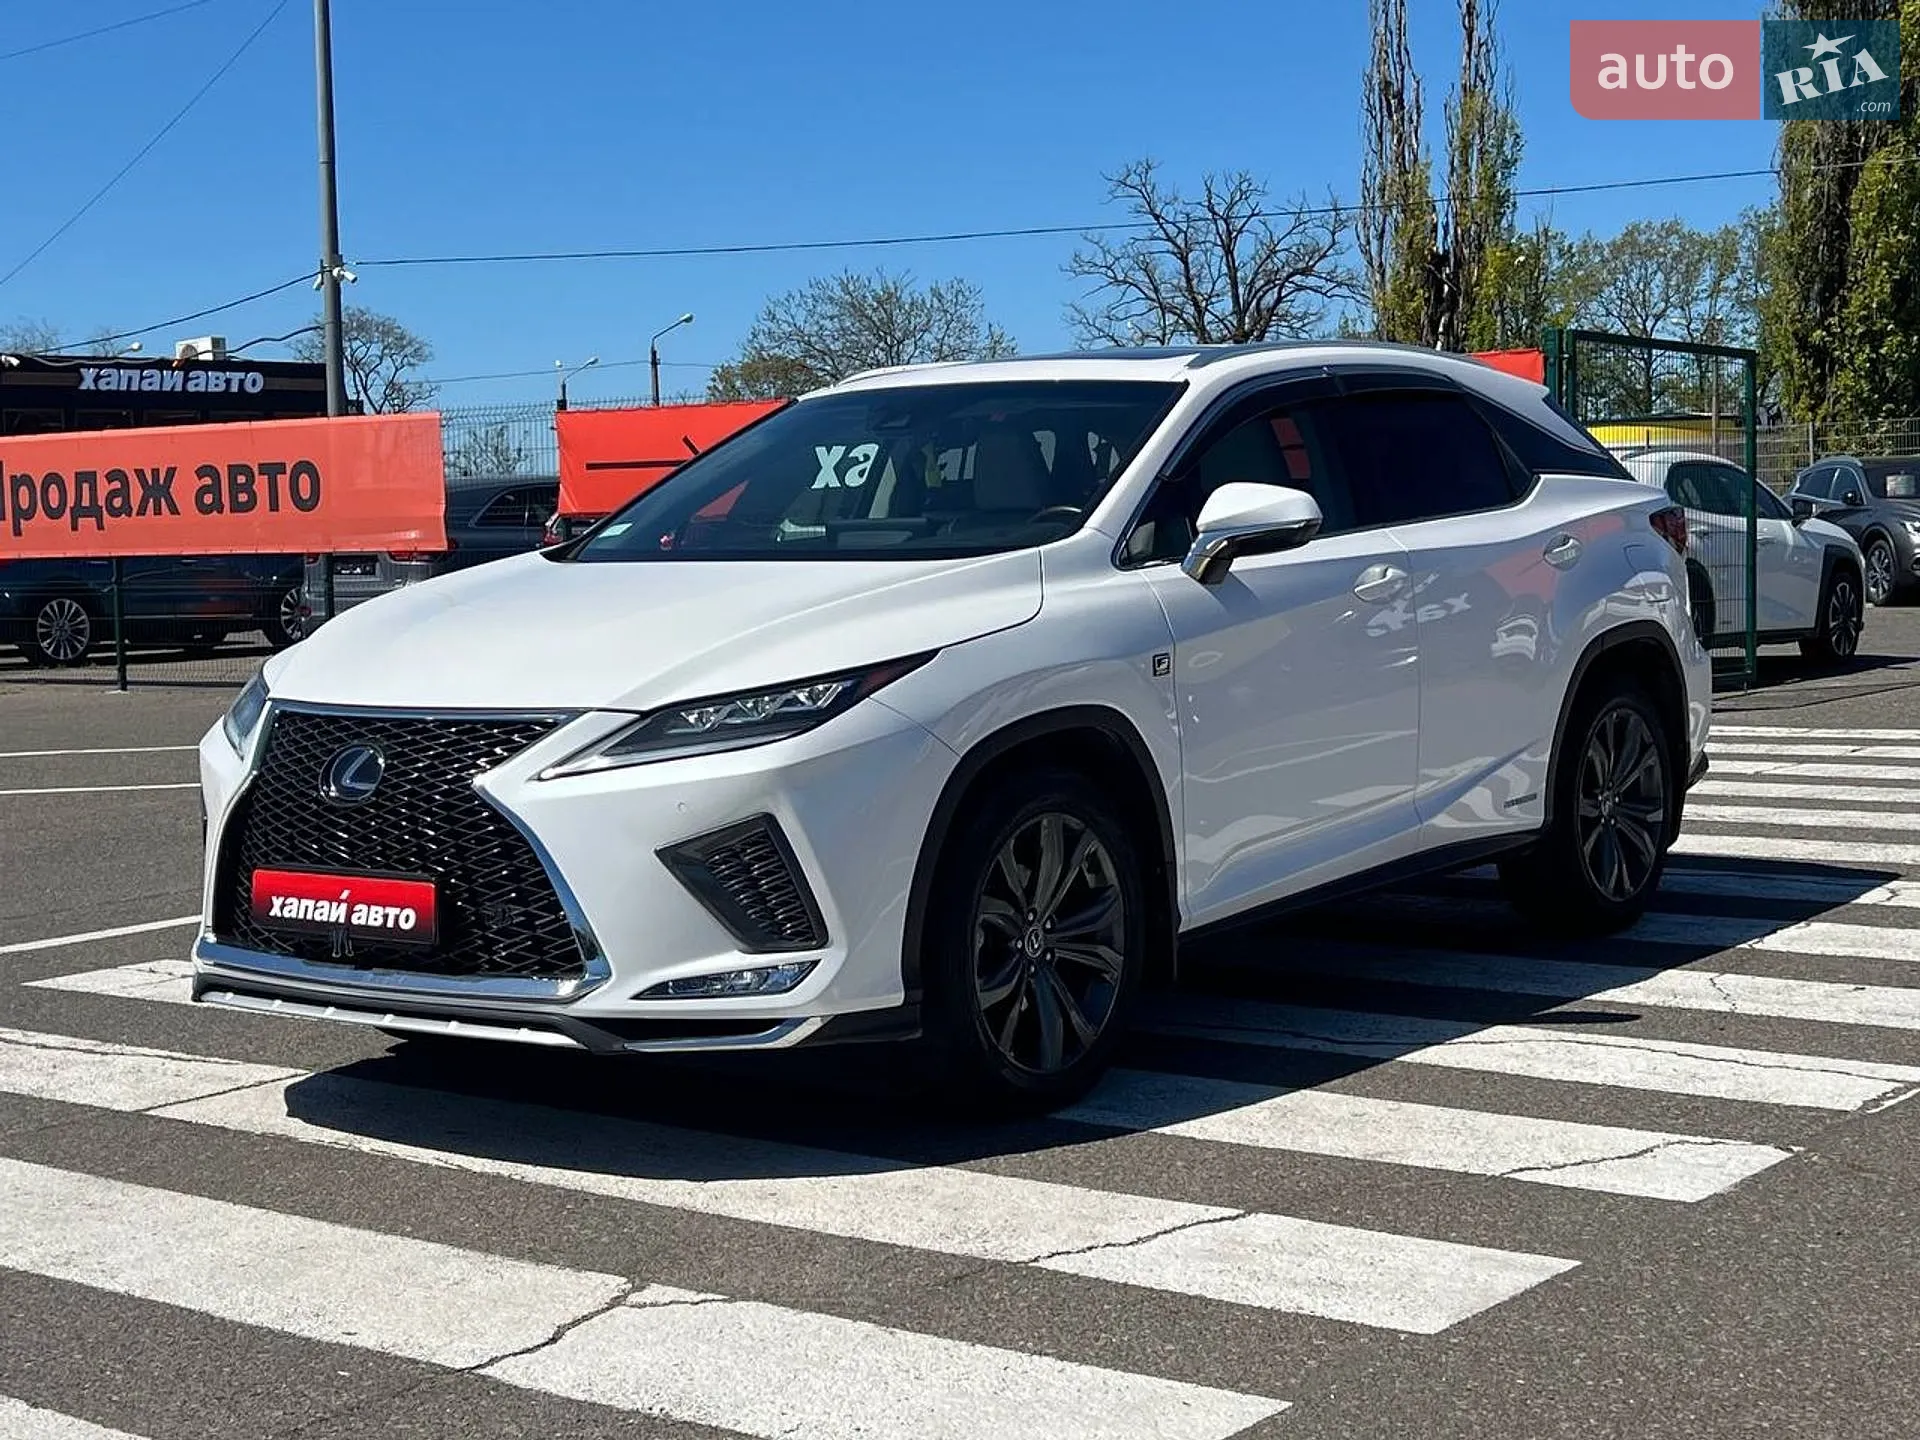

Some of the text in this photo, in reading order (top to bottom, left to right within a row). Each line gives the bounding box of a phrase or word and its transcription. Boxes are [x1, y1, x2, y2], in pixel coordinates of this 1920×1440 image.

[187, 370, 264, 393] авто
[0, 459, 321, 537] родаж авто
[351, 903, 417, 930] авто
